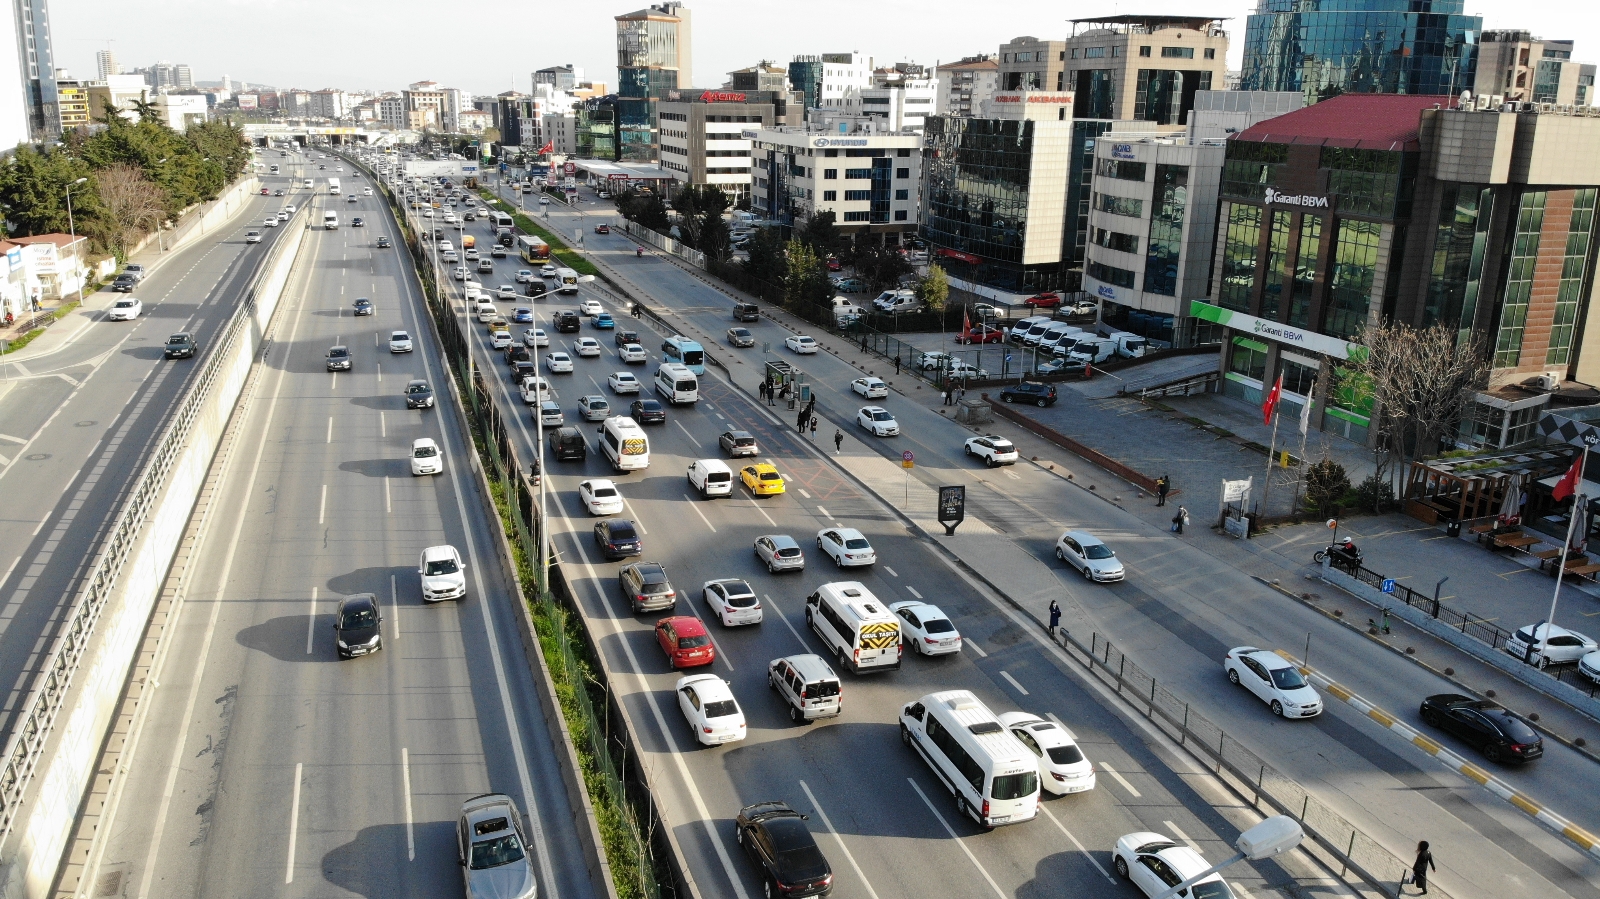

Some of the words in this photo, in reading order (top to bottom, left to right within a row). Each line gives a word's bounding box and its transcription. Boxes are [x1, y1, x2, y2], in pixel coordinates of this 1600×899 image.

[1027, 95, 1073, 104] AKBANK
[1273, 191, 1302, 206] Garanti
[1301, 195, 1329, 208] BBVA
[1261, 323, 1283, 337] Garanti
[1283, 329, 1304, 342] BBVA
[861, 632, 878, 640] OKUL
[878, 630, 897, 638] TAŞITI
